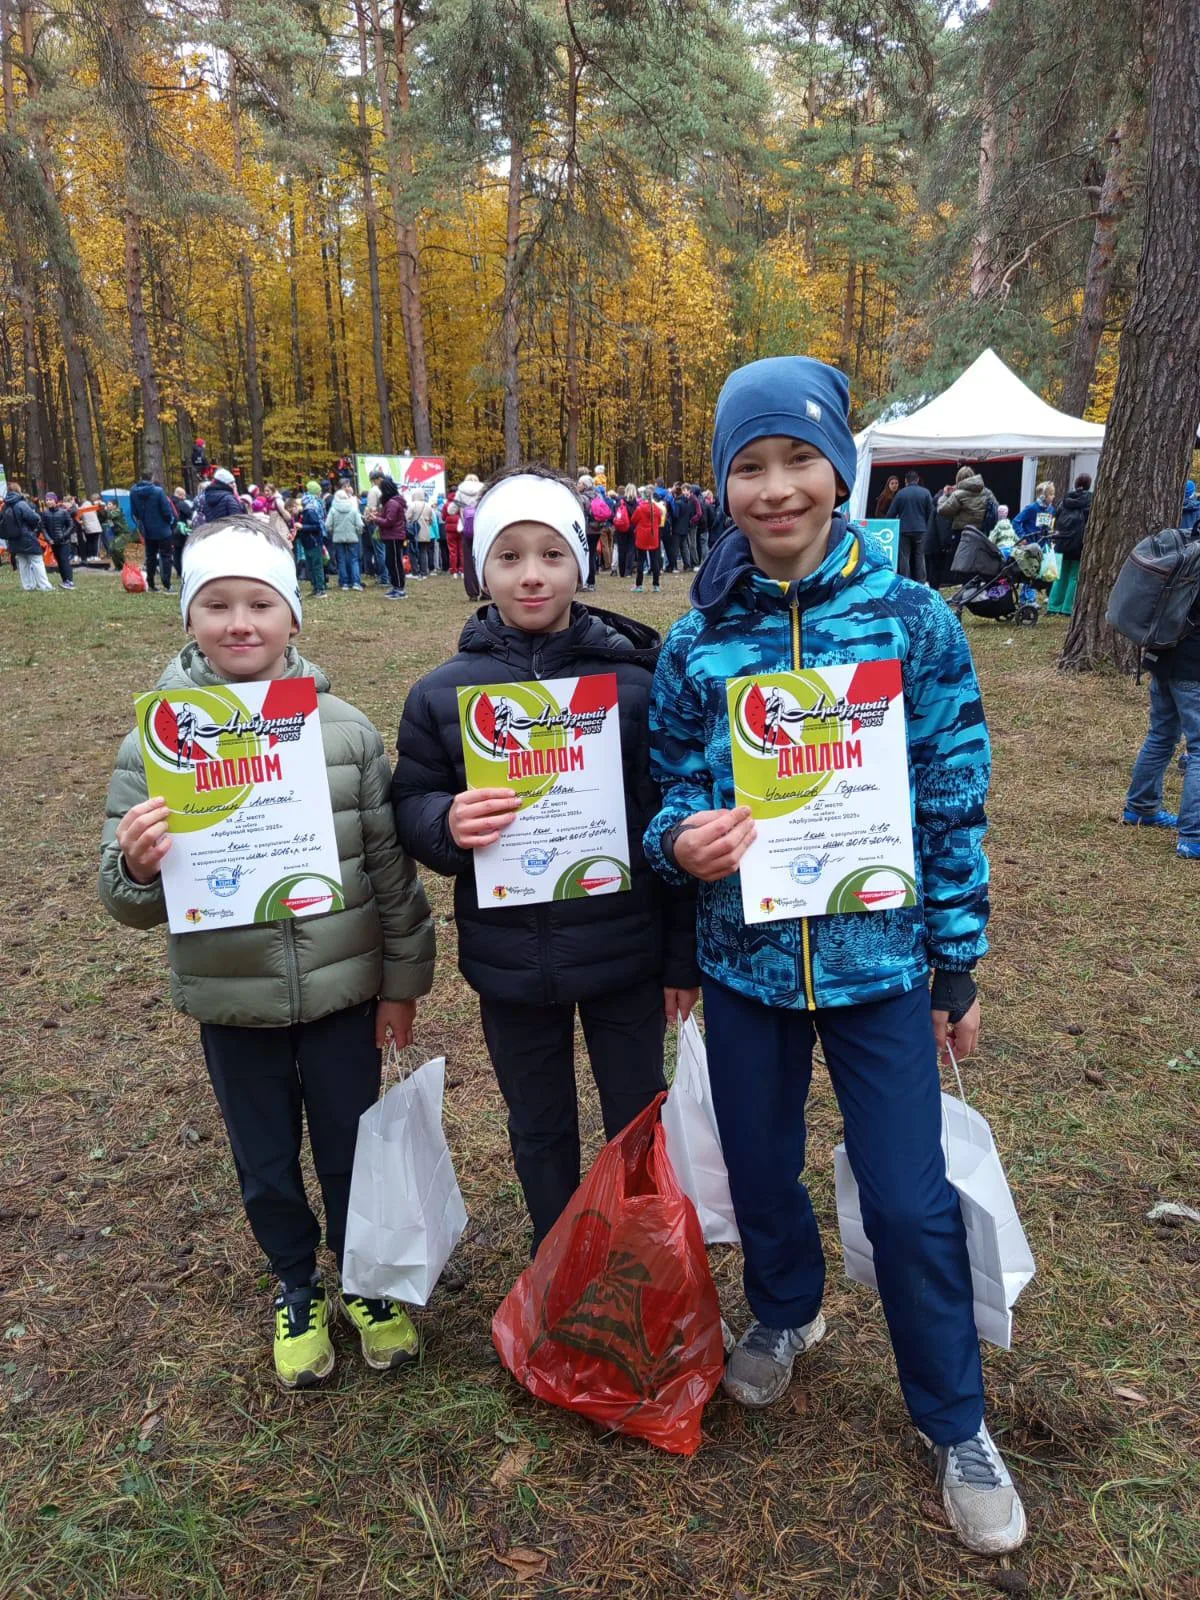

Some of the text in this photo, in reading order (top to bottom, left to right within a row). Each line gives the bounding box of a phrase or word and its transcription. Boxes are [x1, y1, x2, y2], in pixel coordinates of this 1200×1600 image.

[213, 709, 305, 737] Арбузный
[531, 703, 607, 731] Арбузный
[800, 693, 889, 723] Арбузный
[195, 753, 283, 793] ДИПЛОМ
[508, 744, 584, 780] ДИПЛОМ
[776, 739, 863, 779] ДИПЛОМ
